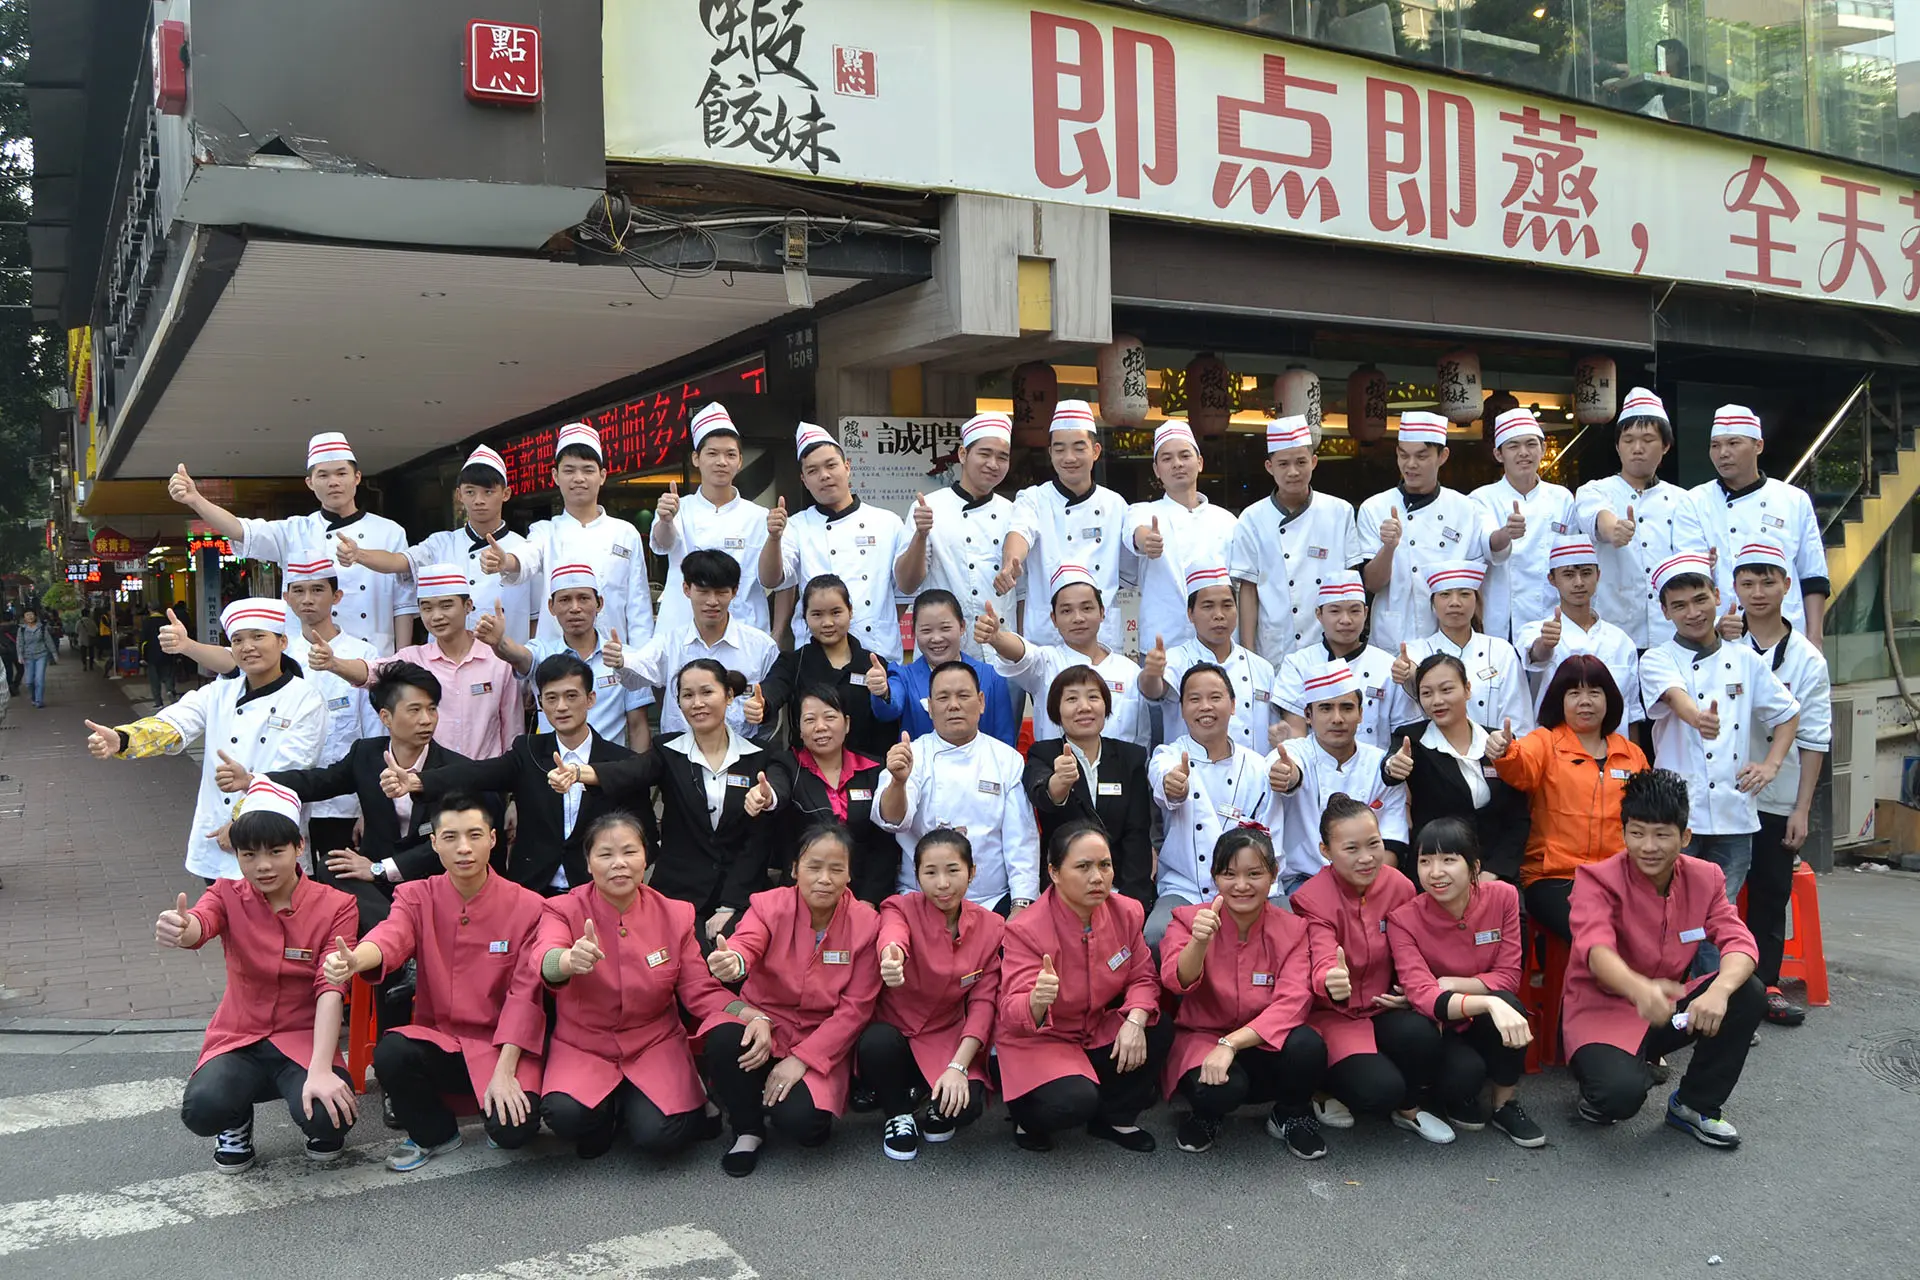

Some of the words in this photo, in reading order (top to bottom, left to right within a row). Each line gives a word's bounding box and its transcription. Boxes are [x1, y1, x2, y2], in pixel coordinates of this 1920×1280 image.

[489, 27, 527, 93] 點心
[695, 68, 841, 175] 餃妹
[788, 348, 813, 370] 150号
